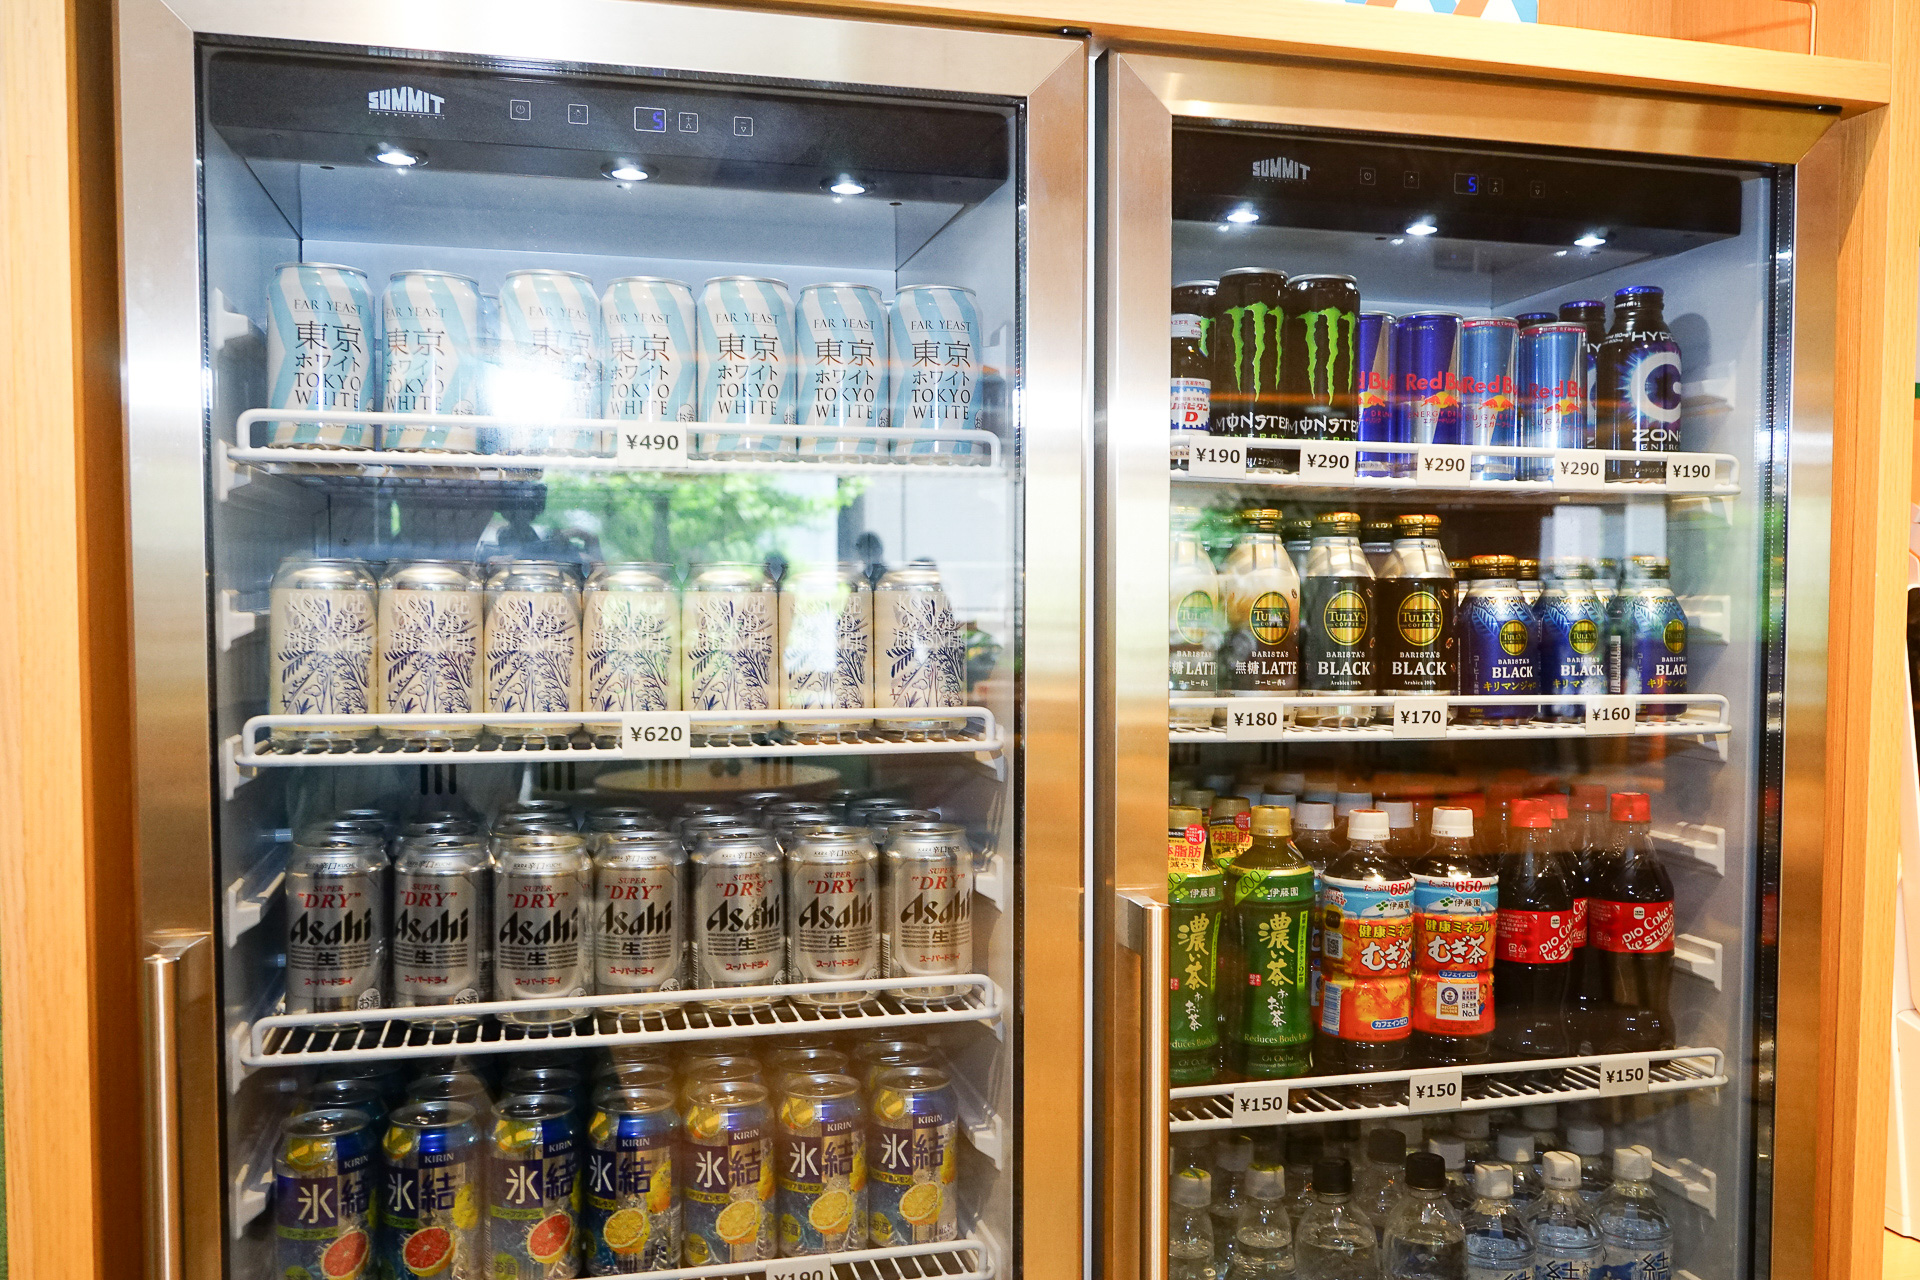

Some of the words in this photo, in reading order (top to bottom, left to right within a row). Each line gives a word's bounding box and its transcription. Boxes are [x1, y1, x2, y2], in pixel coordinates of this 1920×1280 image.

[368, 86, 445, 114] SUMMIT
[1252, 156, 1311, 180] SUMMIT
[294, 300, 319, 310] FAR
[327, 301, 363, 315] YEAST
[716, 313, 739, 323] FAR
[744, 312, 779, 324] YEAST
[814, 319, 836, 329] FAR
[842, 319, 875, 330] YEAST
[911, 320, 933, 330] FAR
[940, 320, 971, 332] YEAST
[295, 321, 361, 354] 東京
[610, 333, 670, 362] 東京
[717, 333, 779, 362] 東京
[814, 338, 875, 367] 東京
[912, 339, 971, 368] 東京
[296, 353, 361, 372] ホワイト
[717, 364, 778, 380] ホワイト
[815, 369, 874, 385] ホワイト
[912, 370, 970, 387] ホワイト
[294, 372, 361, 391] TOKYO
[1406, 371, 1442, 391] Red
[1462, 375, 1500, 394] Red
[717, 383, 779, 399] TOKYO
[814, 387, 875, 402] TOKYO
[912, 388, 971, 404] TOKYO
[1529, 380, 1564, 399] Red
[295, 390, 359, 409] WHITE
[718, 400, 777, 415] WHITE
[816, 404, 873, 419] WHITE
[912, 405, 969, 420] WHITE
[1185, 411, 1199, 422] D
[626, 434, 678, 450] ¥490
[1197, 448, 1240, 463] ¥190
[1307, 454, 1349, 469] ¥290
[1425, 457, 1465, 471] ¥290
[1561, 462, 1599, 475] ¥290
[1673, 464, 1710, 478] ¥190
[1328, 611, 1365, 622] TULLY'S
[1401, 612, 1440, 623] TULLY'S
[1318, 661, 1371, 676] BLACK
[1392, 661, 1447, 676] BLACK
[1492, 666, 1533, 679] BLACK
[1561, 665, 1604, 676] BLACK
[1234, 712, 1277, 726] ¥180
[1400, 710, 1441, 724] ¥170
[1592, 707, 1630, 721] ¥160
[631, 726, 682, 742] ¥620
[733, 873, 760, 881] SUPER
[824, 871, 851, 879] SUPER
[928, 867, 955, 875] SUPER
[313, 884, 344, 893] SUPER
[412, 883, 440, 891] SUPER
[523, 885, 553, 893] SUPER
[1269, 886, 1299, 898] 伊藤園
[900, 888, 971, 925] Asahi
[1454, 898, 1481, 907] 伊藤園
[597, 900, 672, 936] Asahi
[706, 894, 780, 932] Asahi
[799, 893, 872, 930] Asahi
[290, 908, 372, 945] Asahi
[395, 908, 469, 944] Asahi
[499, 908, 578, 945] Asahi
[1425, 919, 1491, 933] 健康ミネラル
[828, 935, 847, 949] 生
[931, 930, 949, 943] 生
[621, 942, 640, 956] 生
[738, 938, 757, 951] 生
[1177, 912, 1210, 991] 濃い茶
[1258, 912, 1295, 987] 濃い茶
[1428, 935, 1487, 965] むぎ茶
[317, 952, 338, 967] 生
[415, 950, 434, 965] 生
[527, 952, 547, 966] 生
[816, 958, 860, 968] スーパードライ
[919, 953, 961, 963] スーパードライ
[610, 966, 655, 975] スーパードライ
[725, 960, 769, 971] スーパードライ
[304, 977, 353, 986] スーパードライ
[404, 975, 449, 984] スーパードライ
[515, 977, 562, 986] スーパードライ
[1244, 1033, 1278, 1044] Reduces
[1606, 1067, 1644, 1083] ¥150
[1416, 1082, 1456, 1099] ¥150
[1240, 1096, 1283, 1112] ¥150
[827, 1121, 852, 1132] KIRIN
[918, 1114, 943, 1124] KIRIN
[733, 1129, 760, 1140] KIRIN
[548, 1140, 573, 1153] KIRIN
[622, 1138, 650, 1147] KIRIN
[424, 1153, 455, 1163] KIRIN
[881, 1132, 944, 1169] 氷結
[344, 1154, 369, 1169] KIRIN
[789, 1140, 854, 1178] 氷結
[590, 1154, 651, 1195] 氷結
[695, 1148, 761, 1188] 氷結
[506, 1155, 580, 1204] 氷結
[388, 1172, 456, 1212] 氷結
